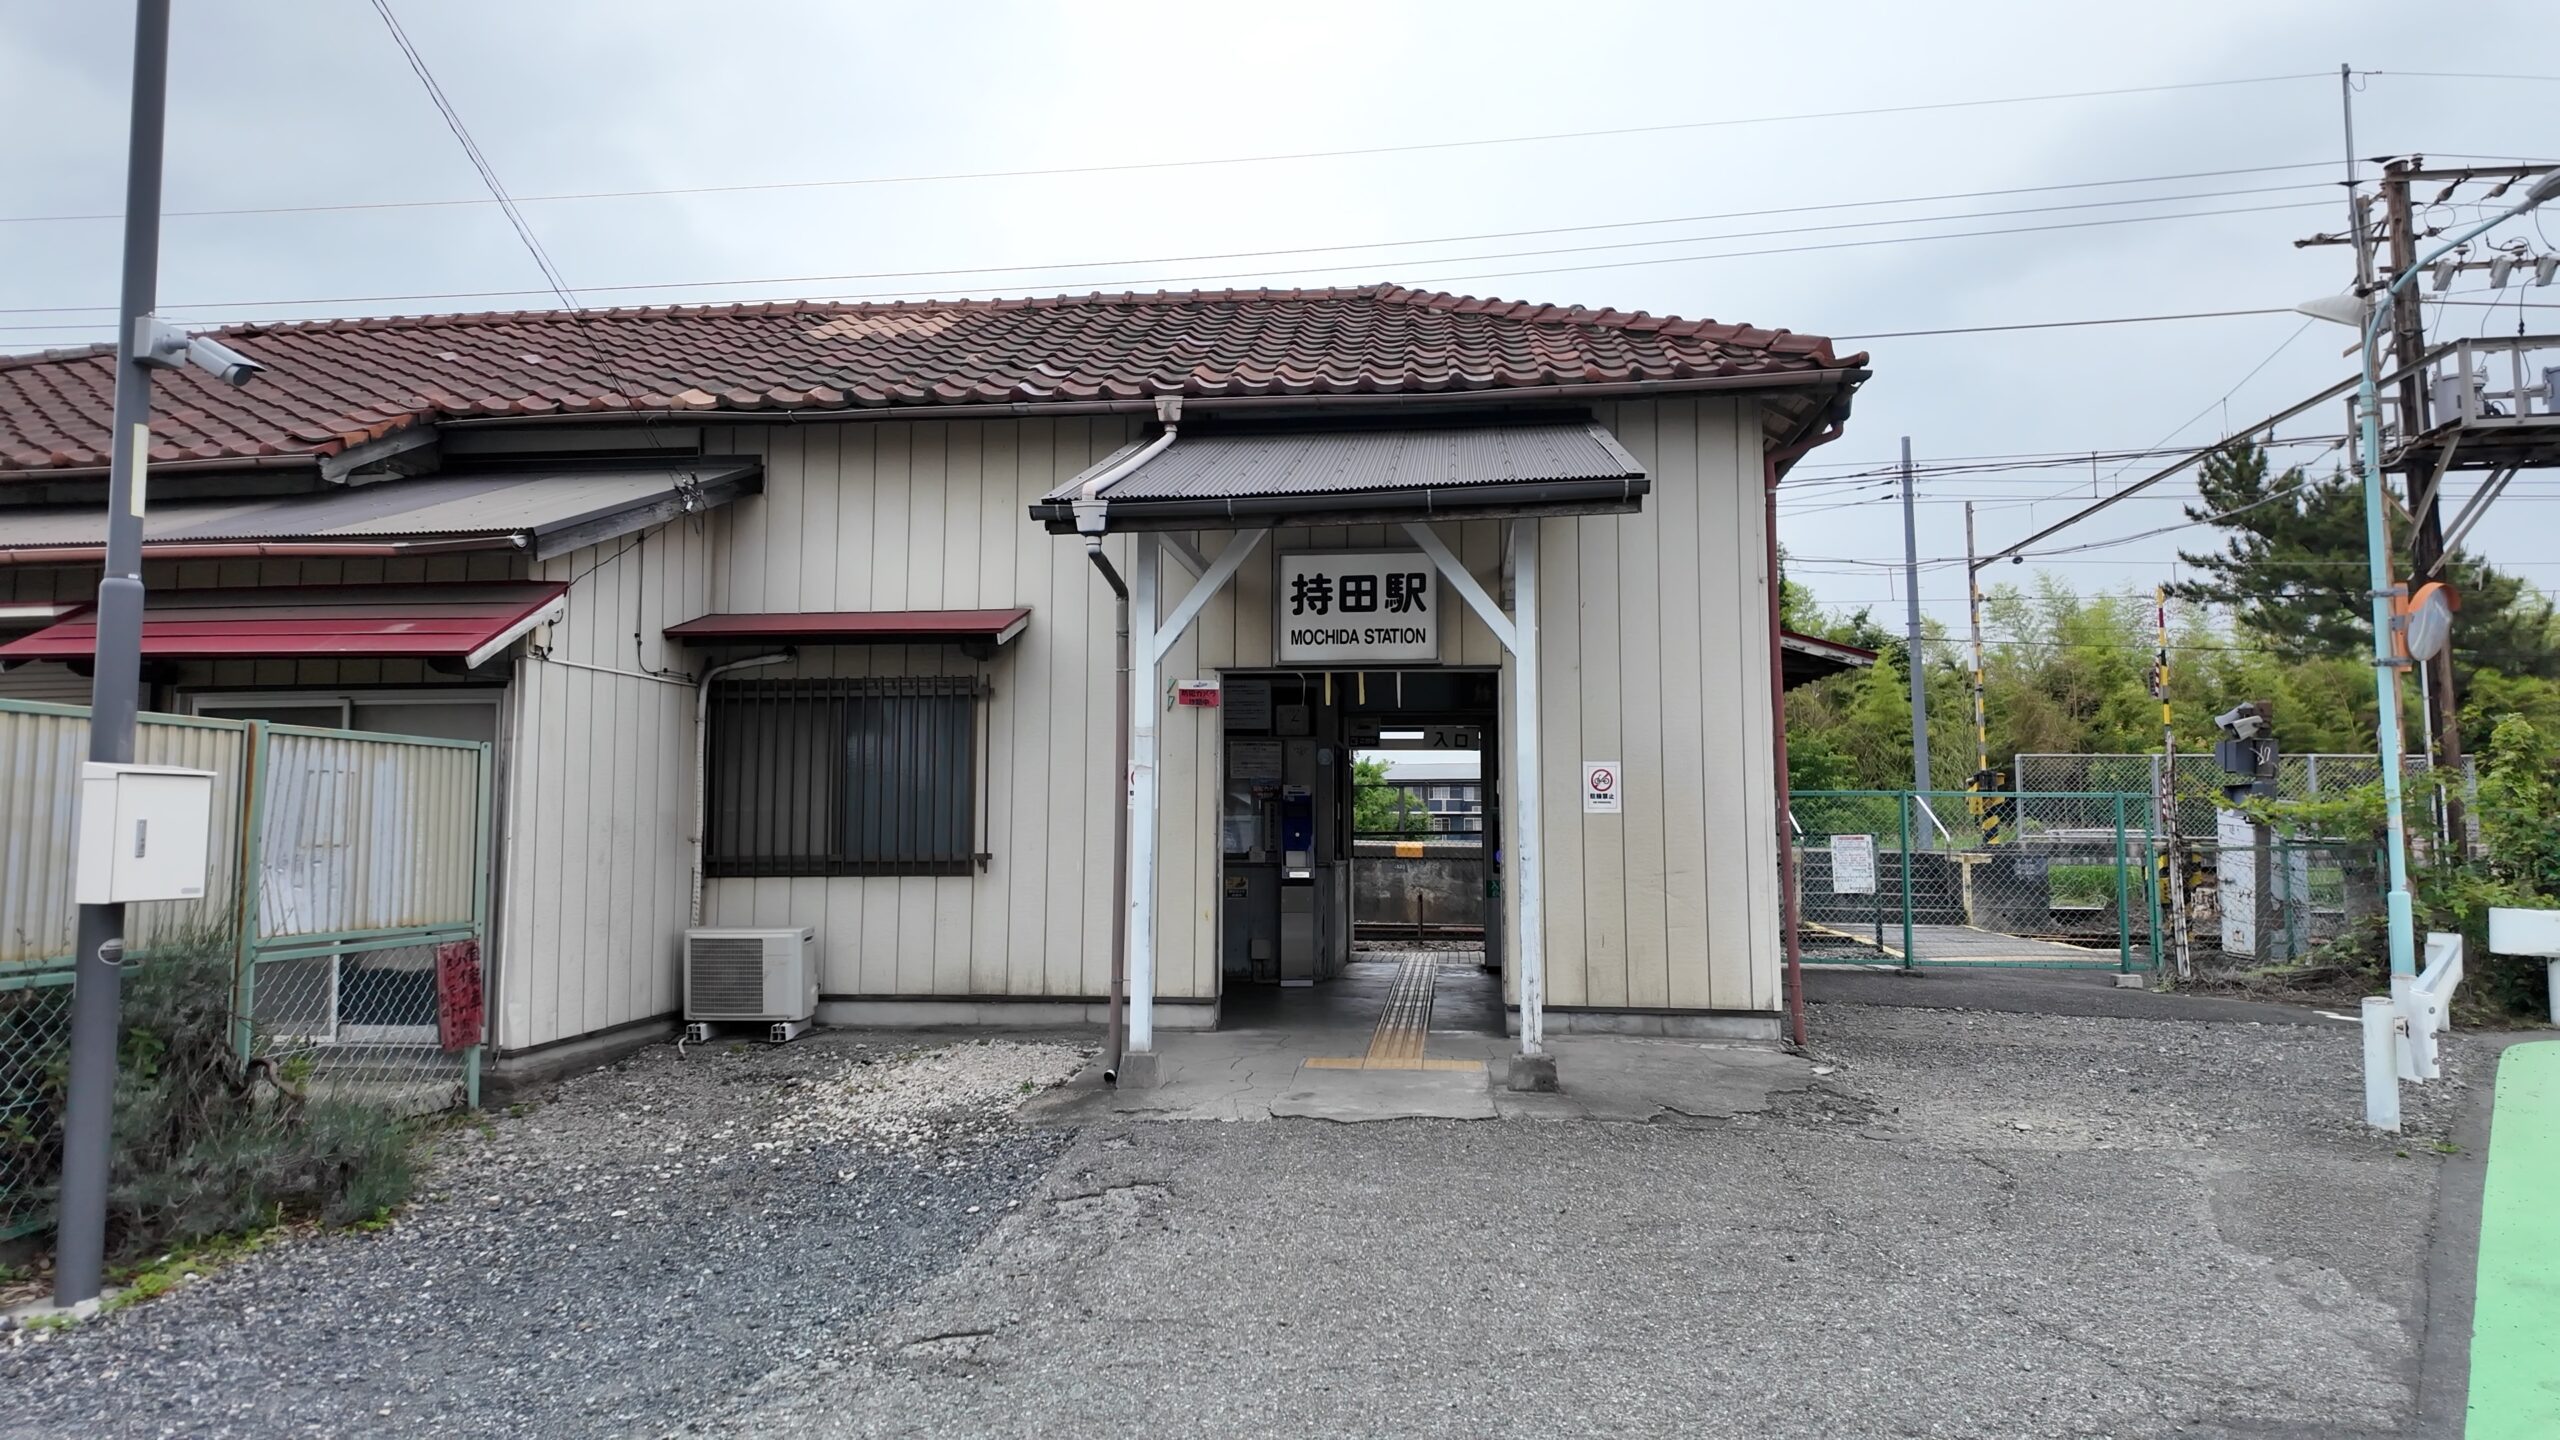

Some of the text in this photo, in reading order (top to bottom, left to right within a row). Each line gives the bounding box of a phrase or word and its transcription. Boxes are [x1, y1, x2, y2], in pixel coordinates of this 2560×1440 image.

[1290, 572, 1427, 615] 持田駅
[1290, 627, 1426, 645] MOCHIDA STATION
[1433, 731, 1468, 747] 入口
